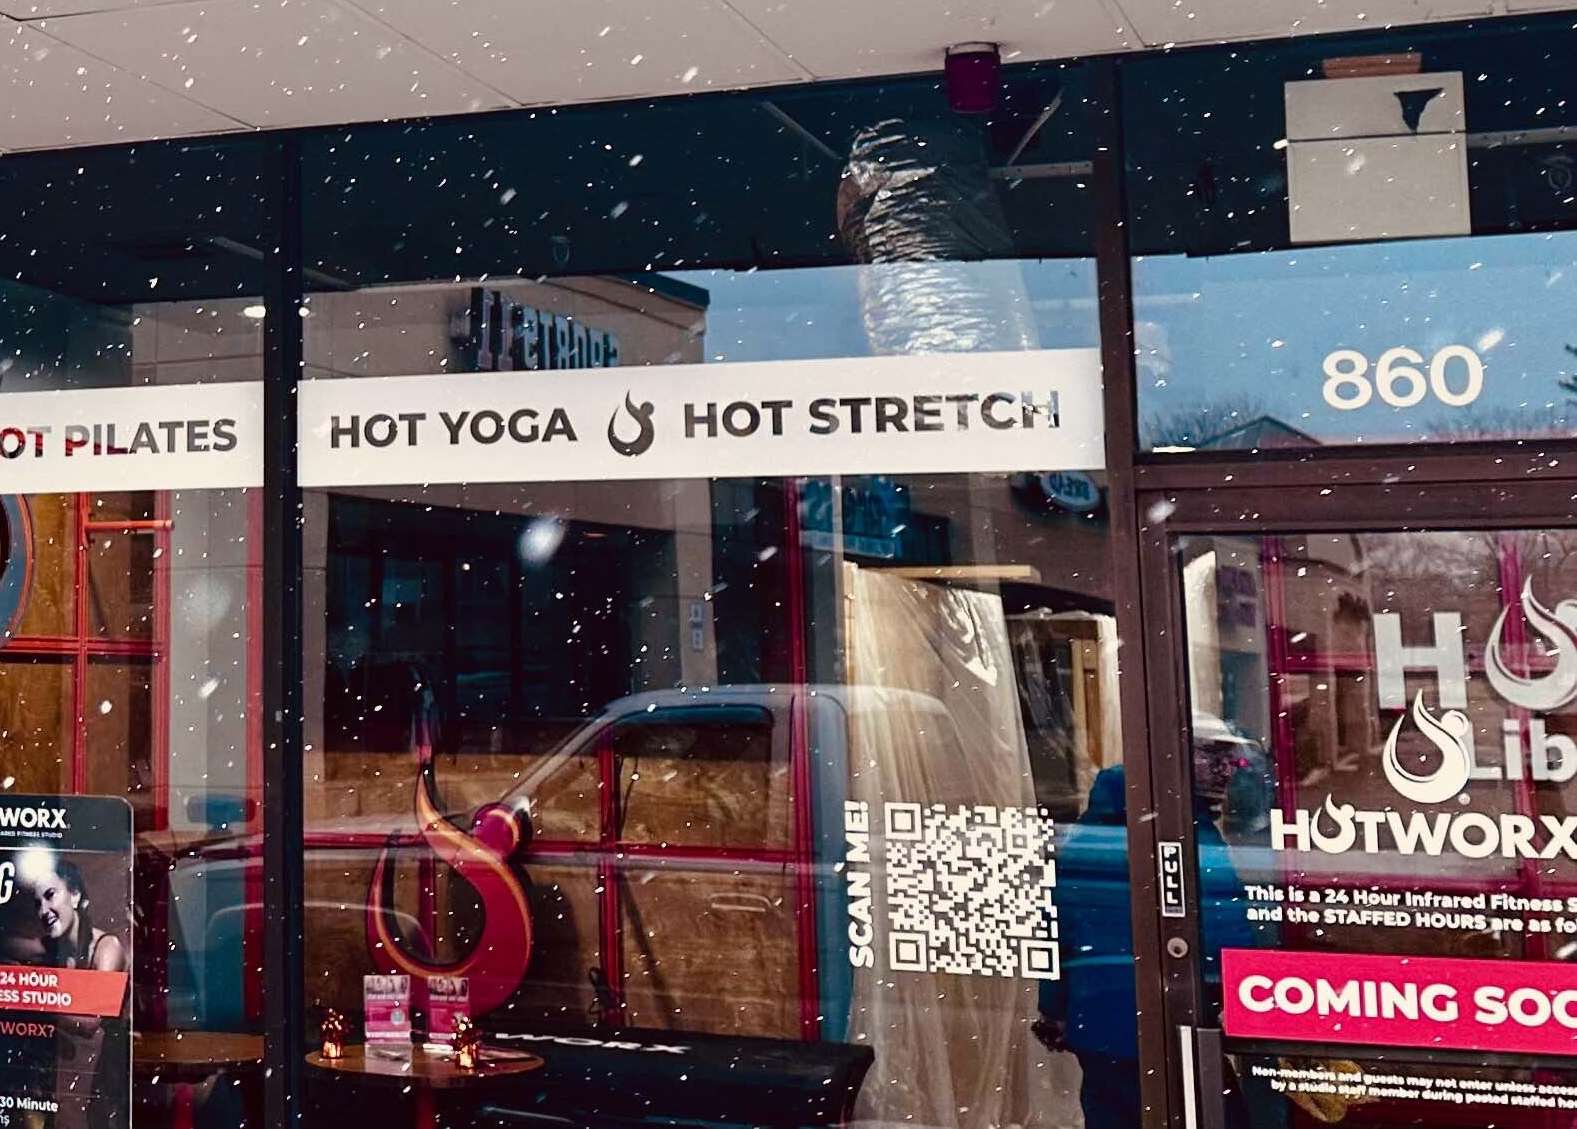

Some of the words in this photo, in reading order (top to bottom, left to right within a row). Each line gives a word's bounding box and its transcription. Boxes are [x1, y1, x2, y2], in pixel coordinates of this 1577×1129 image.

[1323, 345, 1483, 411] 860
[65, 418, 237, 457] PILATES
[331, 413, 425, 449] HOT
[439, 407, 578, 446] YOGA
[685, 399, 793, 439] HOT
[809, 391, 1060, 435] STRETCH
[844, 800, 871, 862] ME!
[1270, 793, 1577, 859] HOTWORX
[1163, 846, 1179, 904] PULL
[1244, 885, 1284, 901] This
[1288, 885, 1305, 902] is
[1309, 890, 1321, 903] a
[1325, 889, 1349, 904] 24
[1353, 889, 1401, 906] Hour
[1405, 891, 1486, 909] Infrared
[1490, 893, 1563, 912] Fitness
[847, 872, 874, 968] SCAN
[1246, 906, 1282, 921] and
[1287, 907, 1320, 923] the
[1324, 908, 1411, 927] STAFFED
[1415, 912, 1487, 930] HOURS
[1490, 918, 1524, 931] are
[1529, 919, 1551, 933] as
[0, 971, 16, 985] 24
[19, 973, 58, 987] HOUR
[1238, 974, 1459, 1022] COMING
[23, 992, 72, 1006] STUDIO
[1271, 1079, 1286, 1092] by
[1288, 1082, 1296, 1091] a
[1298, 1082, 1337, 1093] studio
[1368, 1085, 1420, 1099] member
[1422, 1089, 1464, 1104] during
[1465, 1093, 1509, 1105] posted
[1511, 1095, 1555, 1107] staffed
[1338, 1071, 1361, 1083] and
[1363, 1073, 1405, 1085] guests
[1406, 1076, 1433, 1089] may
[1435, 1078, 1458, 1088] not
[1459, 1079, 1493, 1090] enter
[1495, 1081, 1536, 1093] unless
[0, 1096, 14, 1108] 30
[17, 1097, 58, 1112] Minute
